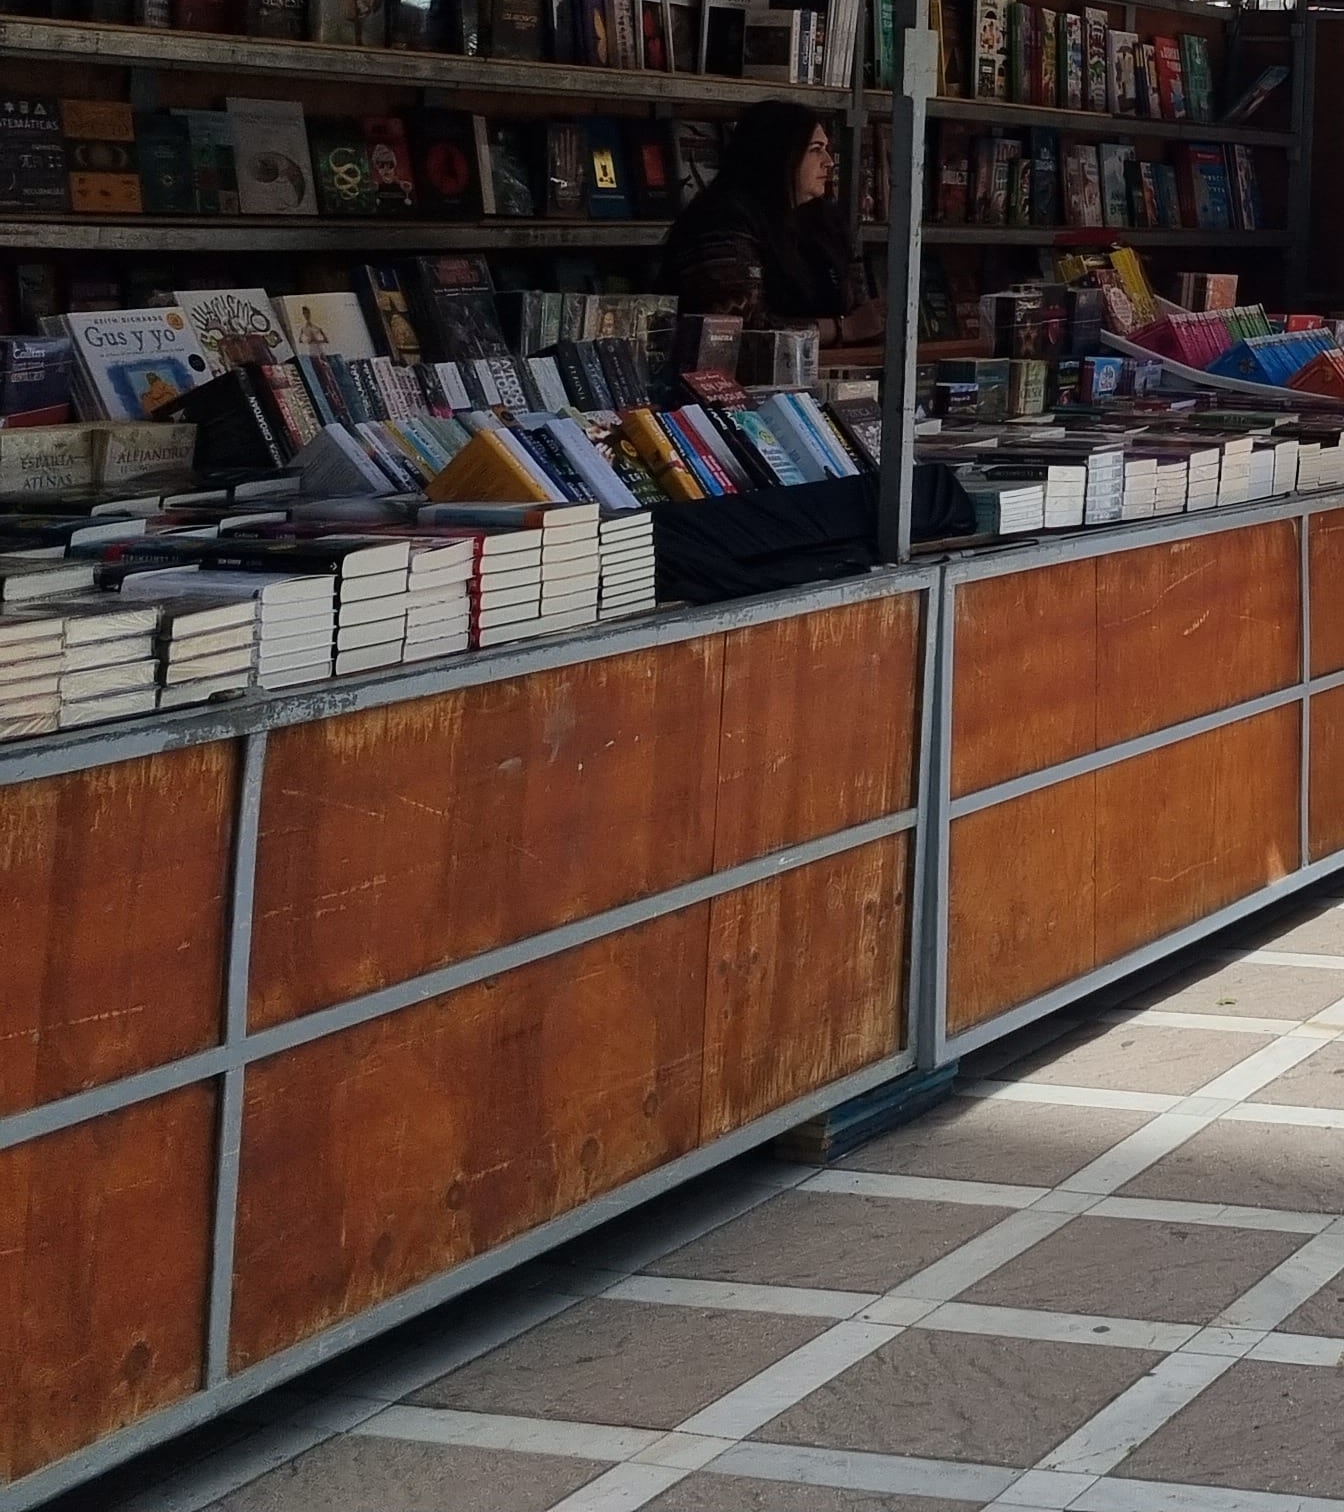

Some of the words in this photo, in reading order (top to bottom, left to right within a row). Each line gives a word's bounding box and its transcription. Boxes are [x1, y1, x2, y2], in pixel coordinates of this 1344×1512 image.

[84, 325, 127, 348] Gus
[131, 329, 144, 351] y
[149, 328, 176, 350] yo
